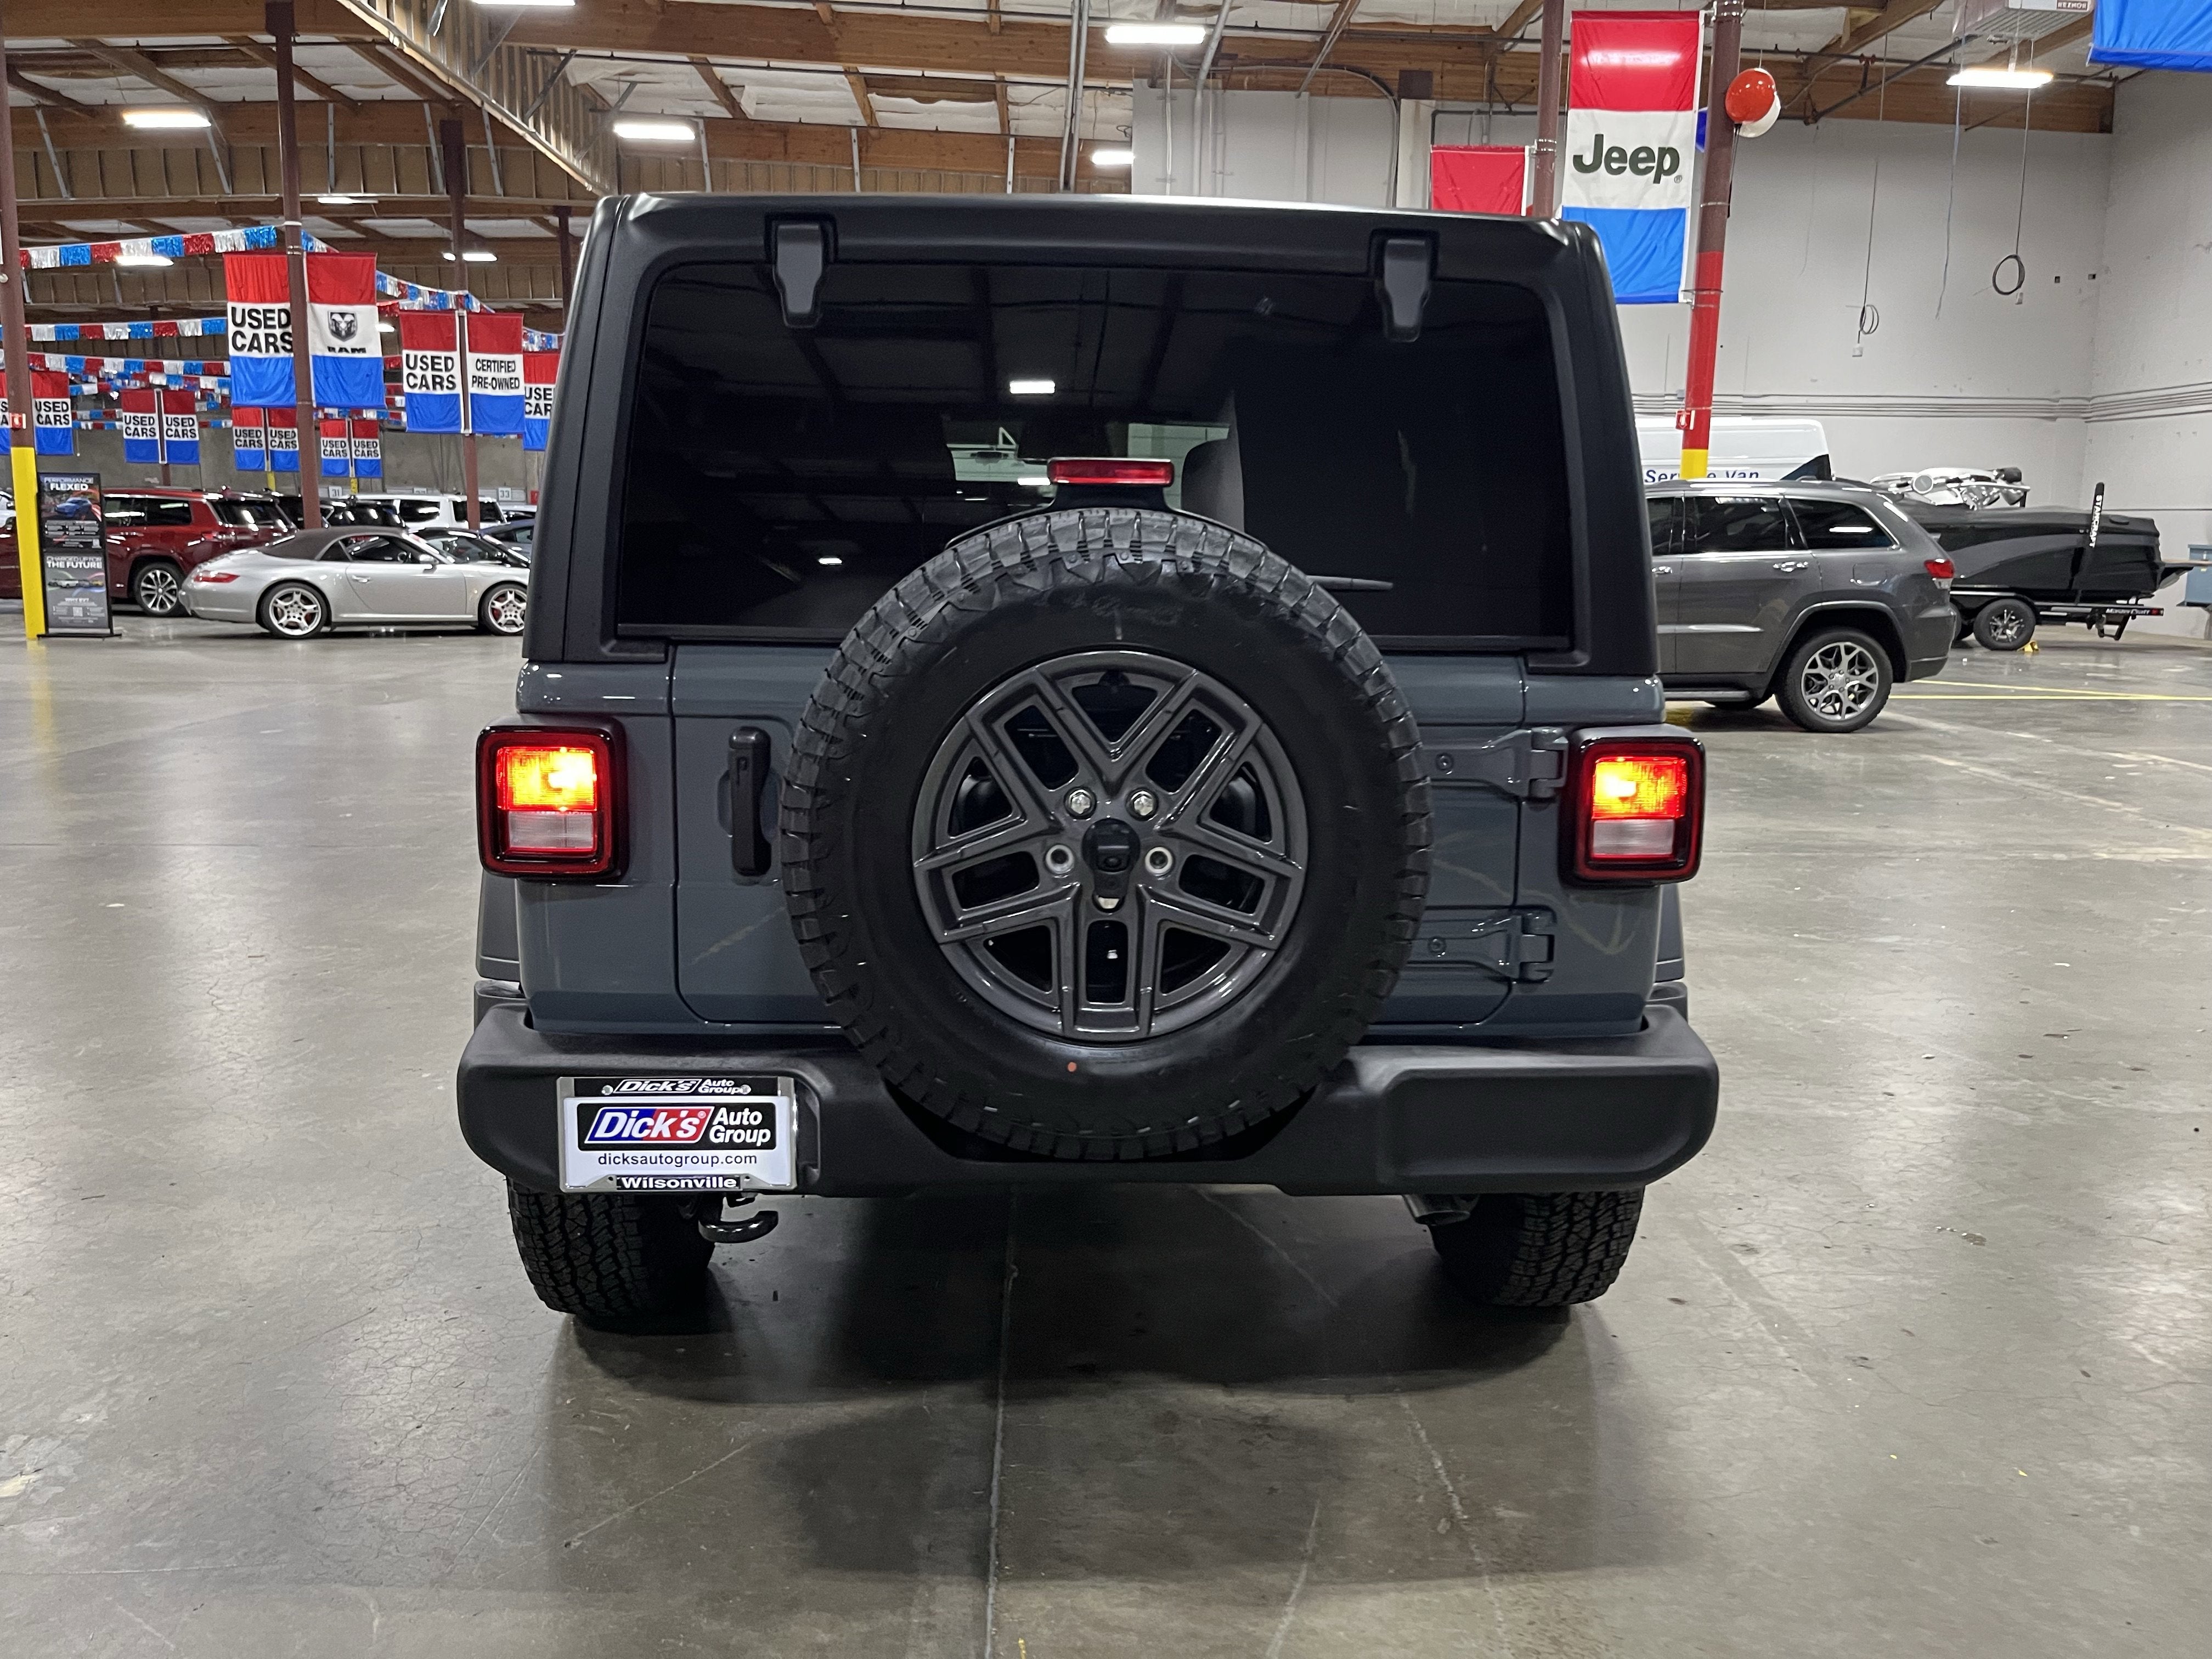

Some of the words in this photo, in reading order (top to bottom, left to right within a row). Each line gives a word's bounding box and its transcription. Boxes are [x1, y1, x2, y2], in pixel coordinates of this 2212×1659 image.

[1573, 134, 1680, 184] Jeep
[231, 307, 291, 329] USED
[232, 330, 292, 353] CARS
[406, 354, 454, 372] USED
[476, 358, 516, 373] CERTIFIED
[406, 373, 456, 391] CARS
[472, 375, 520, 390] PRE-OWNED
[525, 386, 552, 400] USE
[35, 401, 69, 412] USED
[525, 403, 552, 416] CAR
[36, 414, 70, 425] CARS
[125, 415, 155, 426] USED
[166, 417, 195, 427] USED
[125, 427, 156, 437] CARS
[166, 428, 197, 438] CARS
[235, 429, 262, 438] USED
[270, 430, 296, 439] USED
[235, 439, 263, 448] CARS
[270, 439, 297, 449] CARS
[323, 440, 347, 448] USED
[354, 441, 378, 449] USED
[323, 449, 348, 457] CARS
[354, 449, 379, 458] CARS
[1645, 470, 1716, 483] Sere
[1726, 470, 1759, 478] Van
[500, 490, 510, 498] 33
[619, 1080, 692, 1091] Dick's
[701, 1079, 735, 1087] Auto
[698, 1086, 744, 1094] Group
[712, 1107, 763, 1126] Auto
[594, 1110, 701, 1138] Dick's
[709, 1125, 771, 1147] Group
[597, 1153, 758, 1167] dicksautogroup.com
[620, 1176, 737, 1189] Wilsonville
